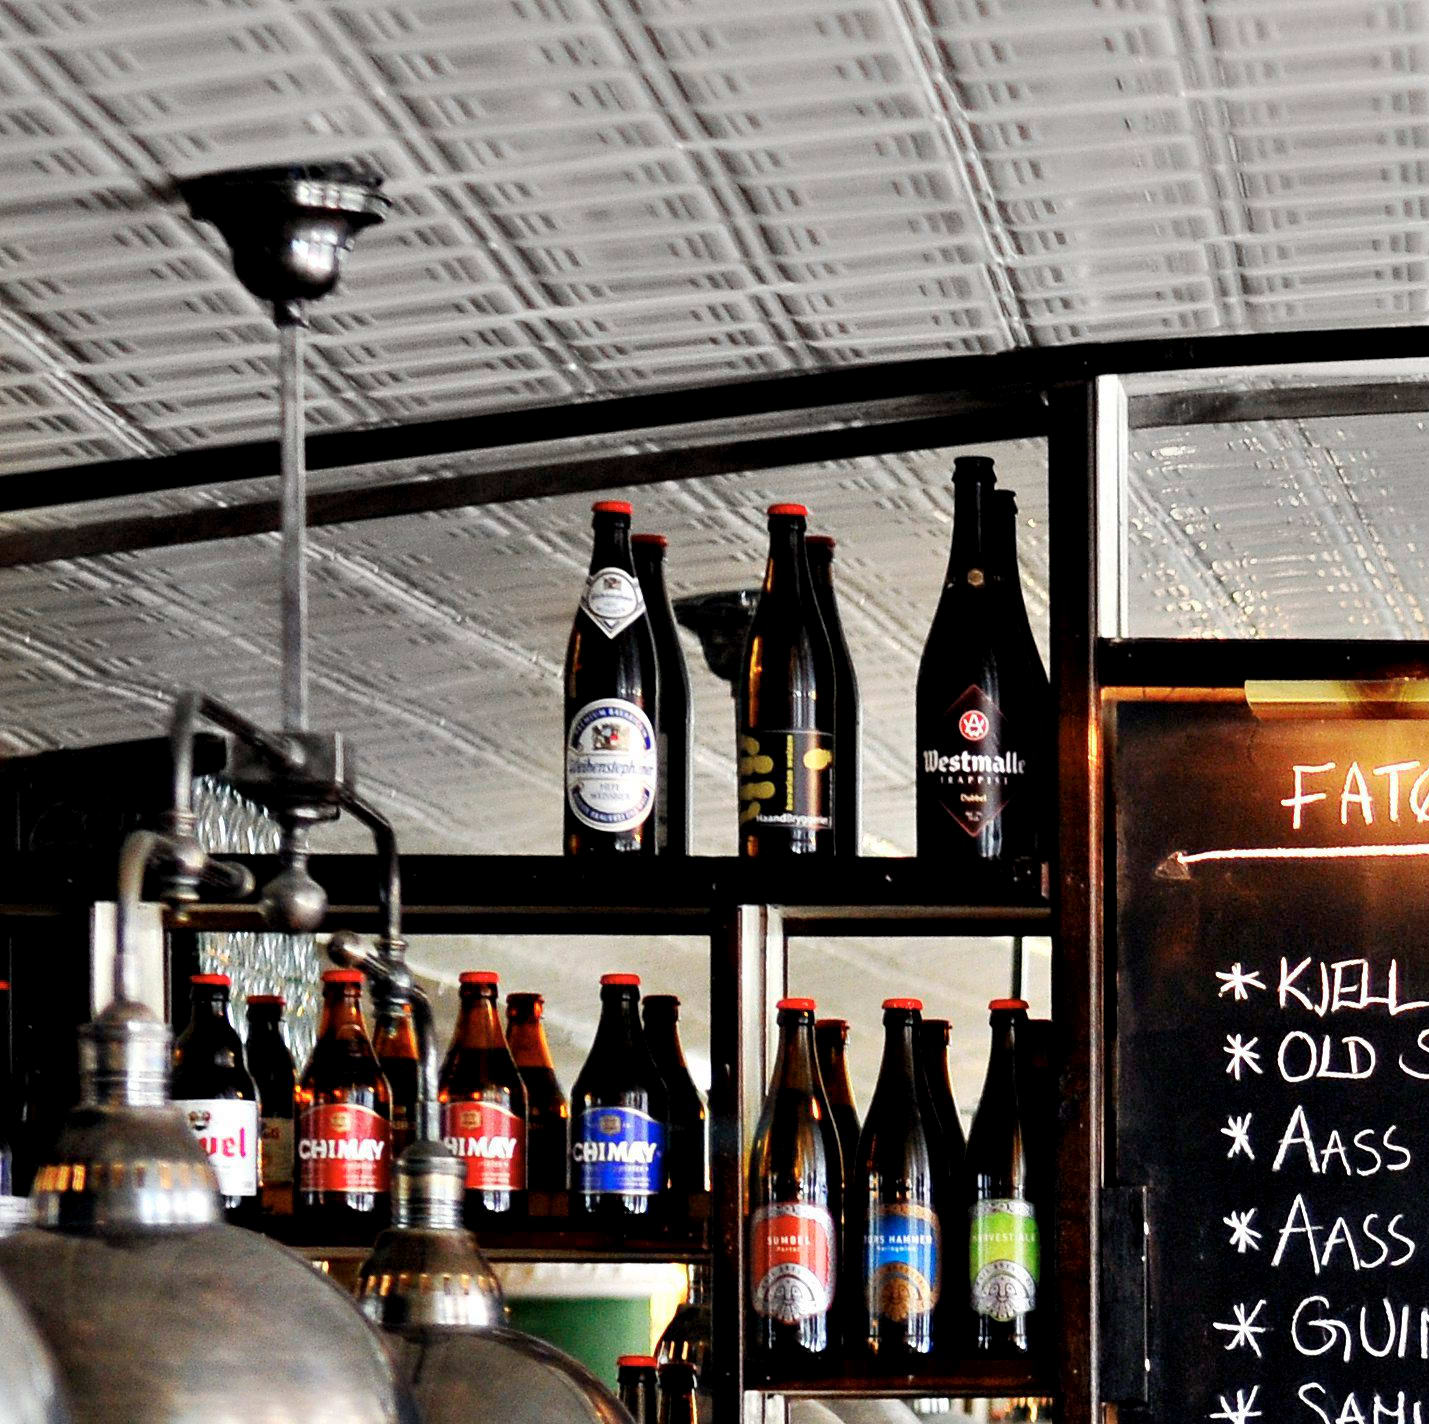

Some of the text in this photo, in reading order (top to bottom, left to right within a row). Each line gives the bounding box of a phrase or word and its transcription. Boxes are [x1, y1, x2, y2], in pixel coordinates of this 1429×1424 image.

[923, 749, 1026, 774] Westmalle
[1277, 1031, 1376, 1082] OLD
[299, 1138, 385, 1161] CHIMAY
[445, 1136, 517, 1159] HIMAY
[572, 1141, 658, 1164] CHIMAY
[1272, 1105, 1411, 1176] AASS
[1271, 1193, 1415, 1275] AASS
